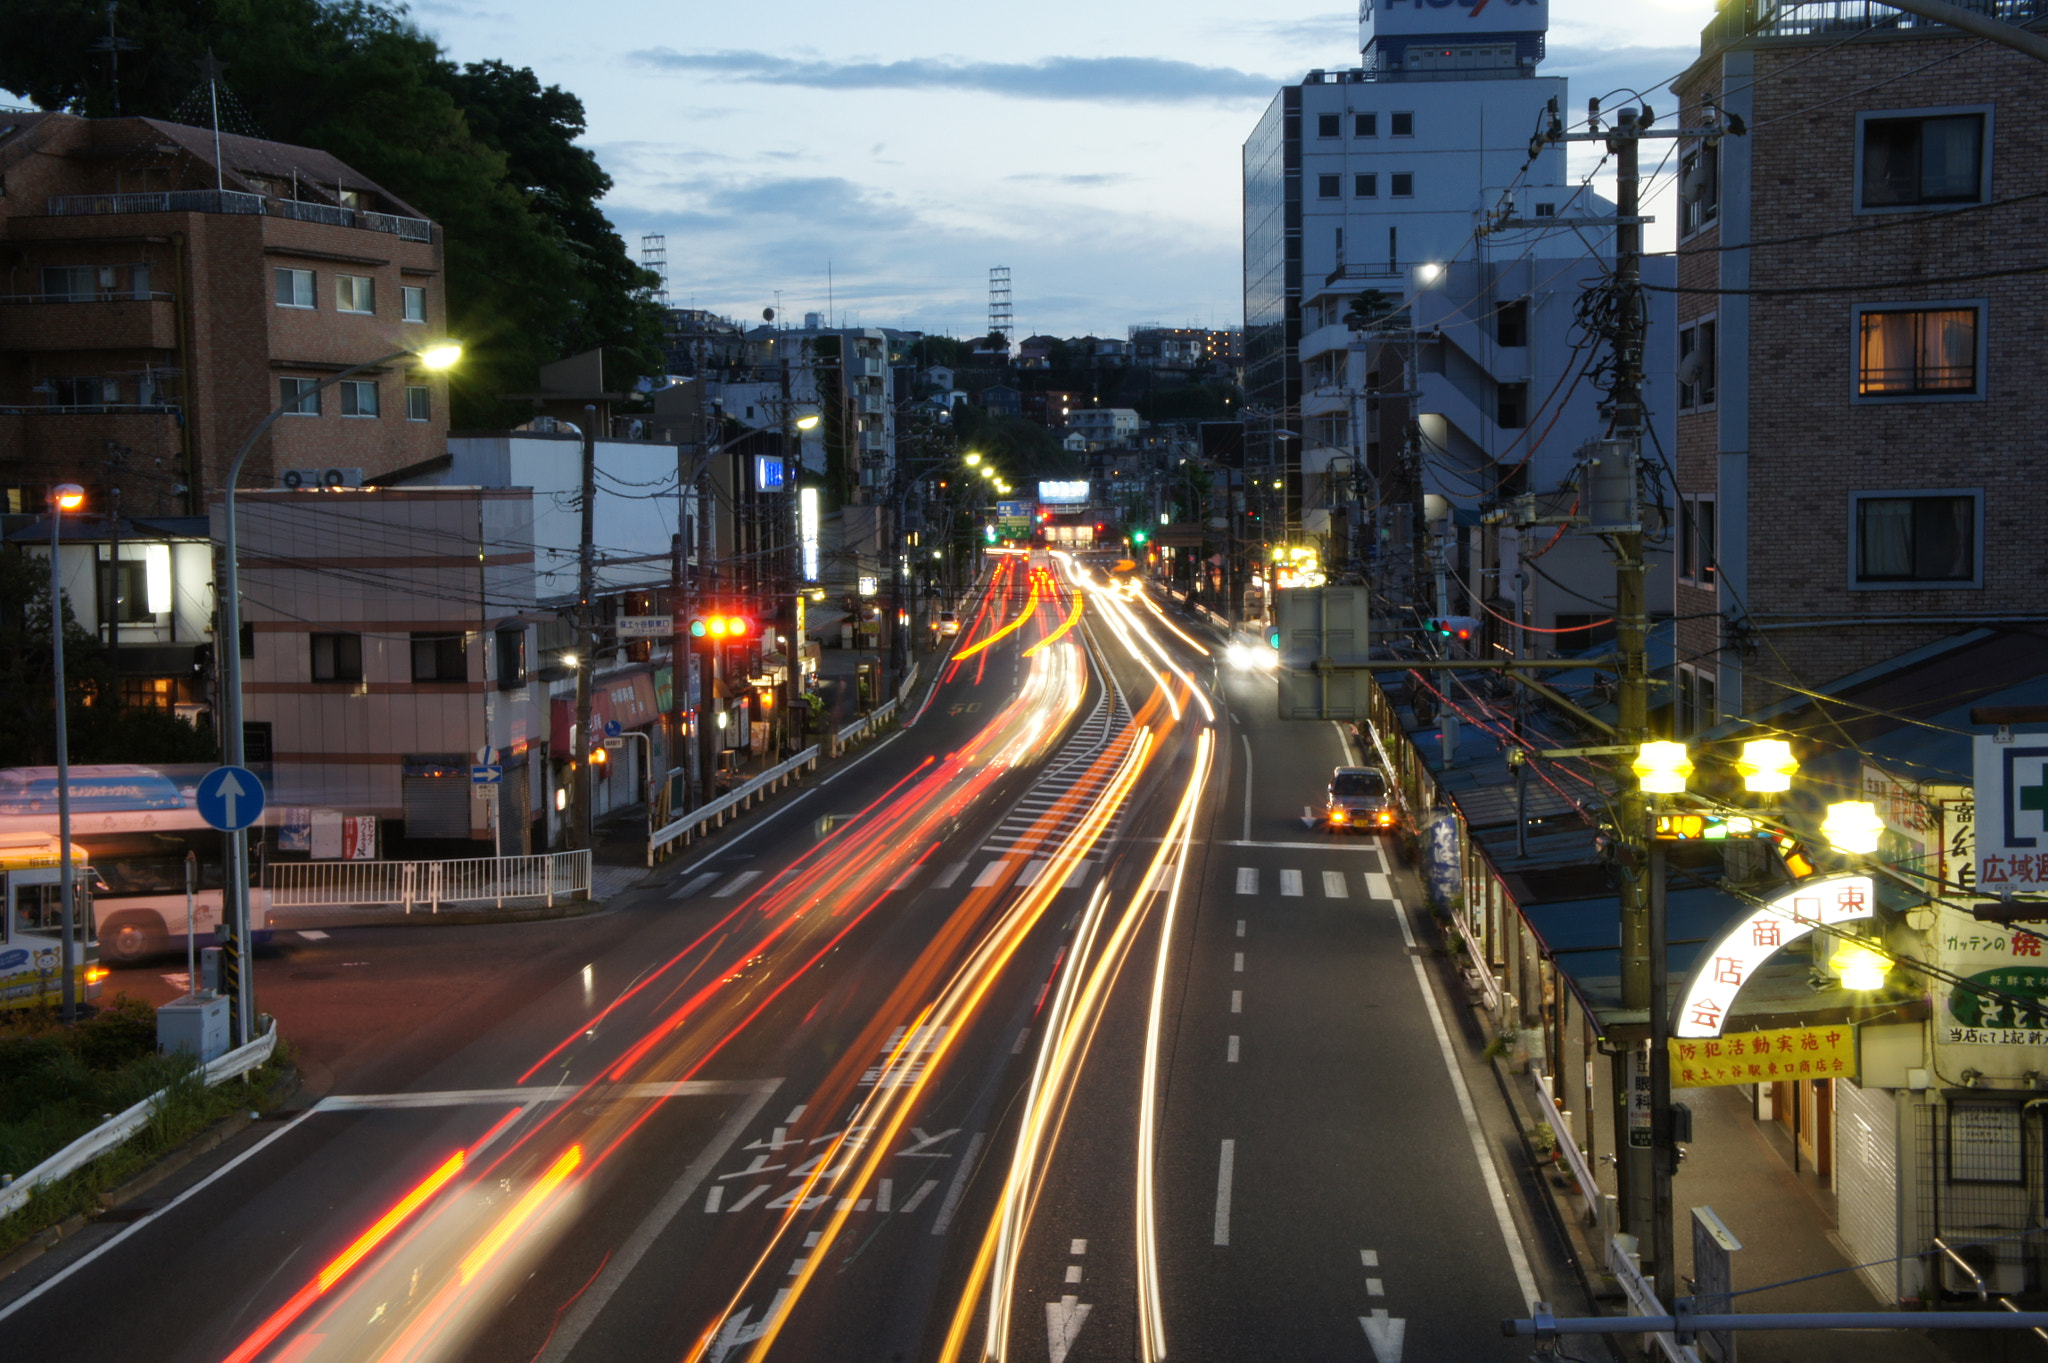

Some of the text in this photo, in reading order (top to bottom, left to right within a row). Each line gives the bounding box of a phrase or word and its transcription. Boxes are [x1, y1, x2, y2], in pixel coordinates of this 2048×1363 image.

[1691, 885, 1865, 1029] 東口商店会
[1679, 1030, 1841, 1061] 防犯活動実施中
[1681, 1058, 1844, 1083] 保土ヶ谷駅東口商店会
